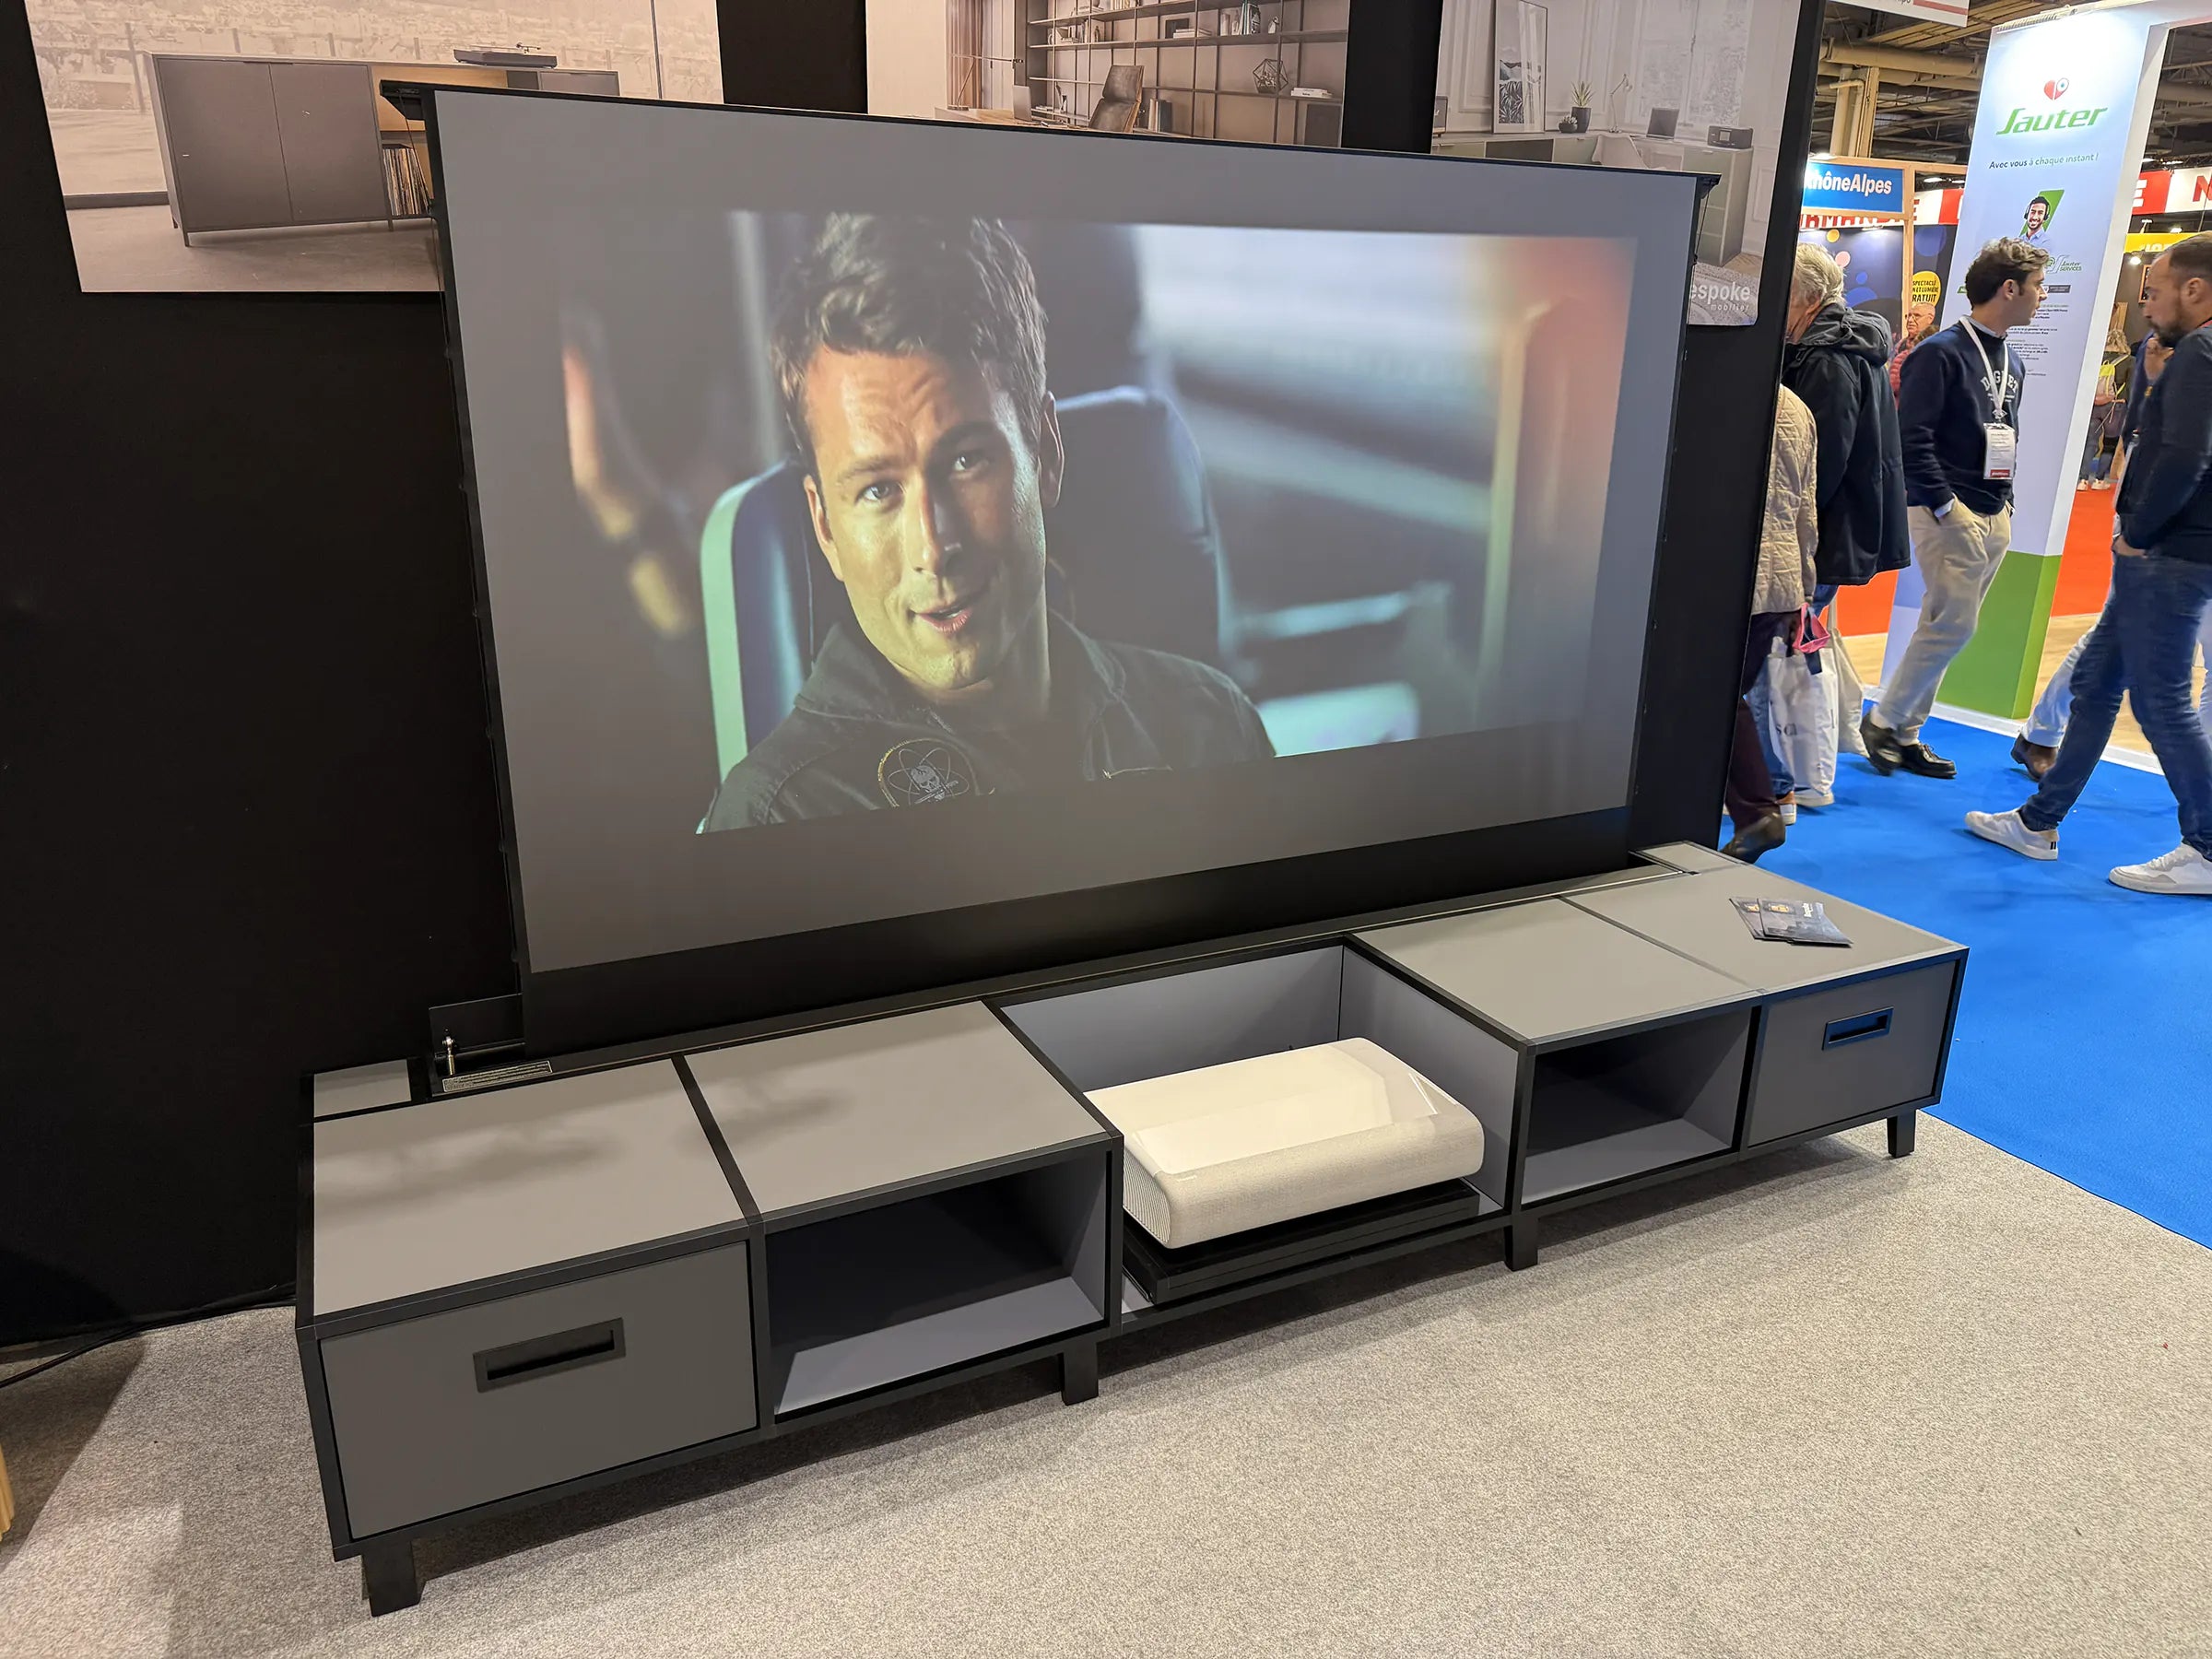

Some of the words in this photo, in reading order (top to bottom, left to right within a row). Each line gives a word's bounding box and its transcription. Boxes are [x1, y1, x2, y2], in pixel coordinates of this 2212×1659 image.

[1995, 107, 2108, 135] Sauter
[2035, 157, 2064, 166] chaque
[1691, 281, 1750, 305] espoke
[1912, 294, 1936, 302] RATUIT
